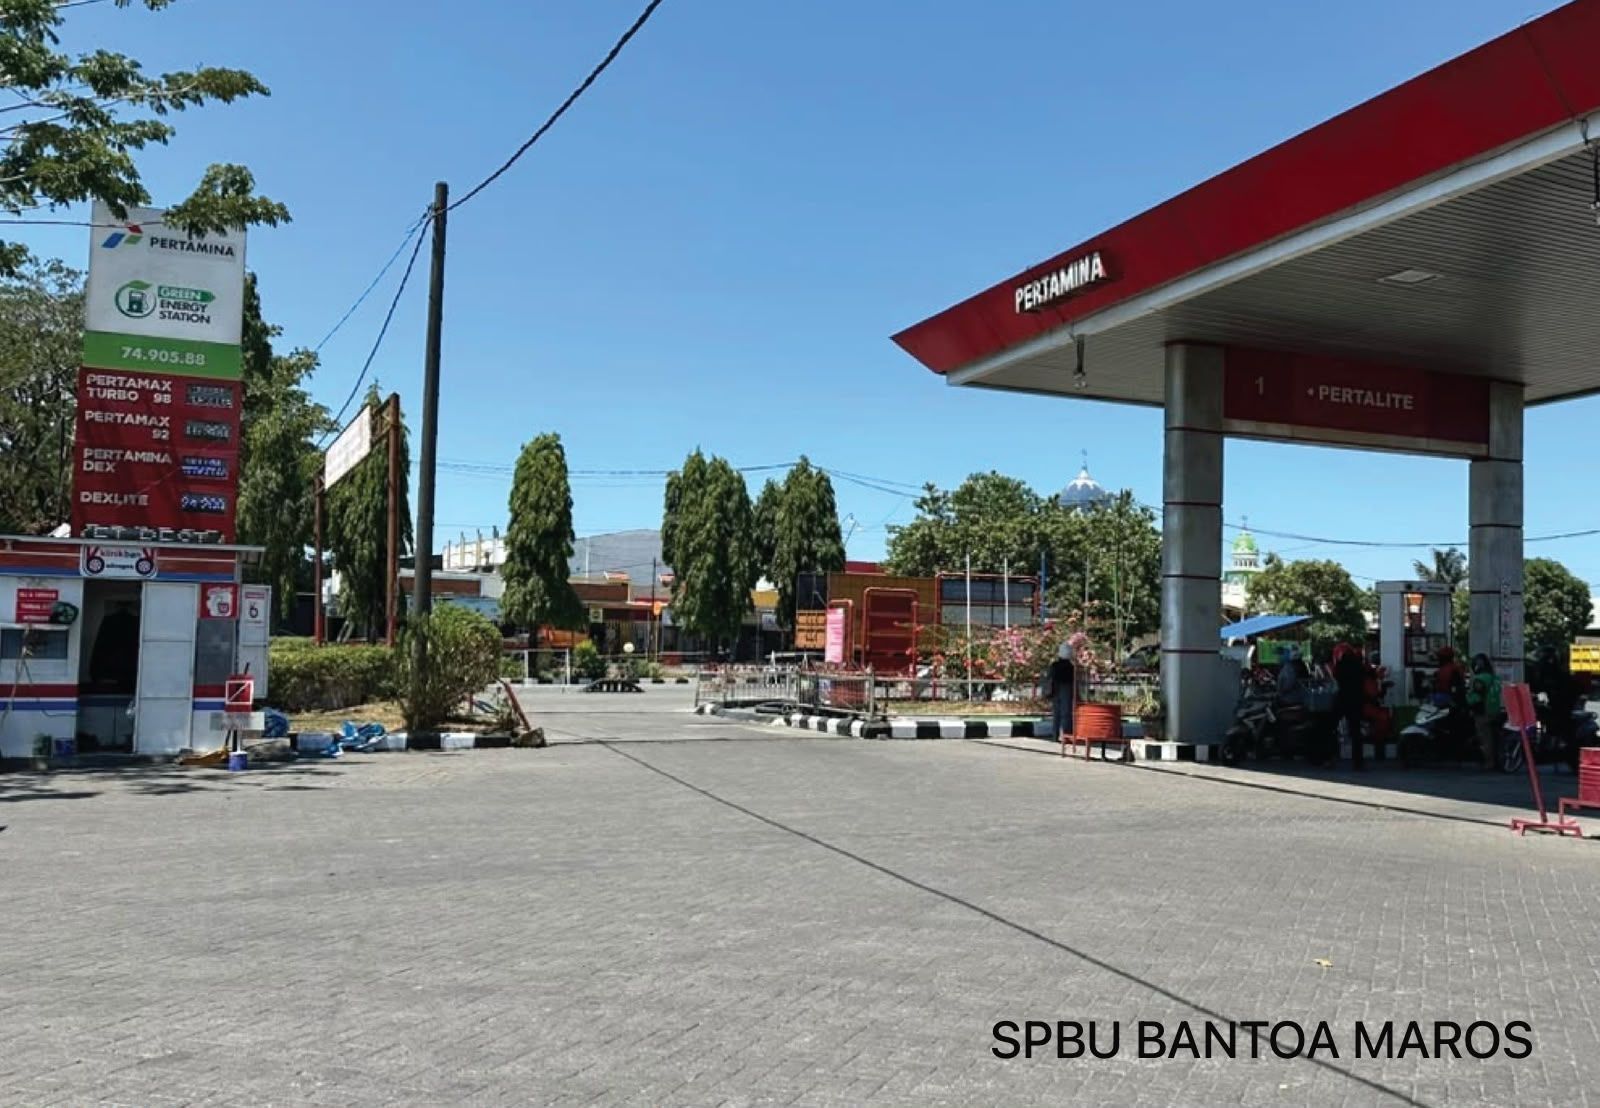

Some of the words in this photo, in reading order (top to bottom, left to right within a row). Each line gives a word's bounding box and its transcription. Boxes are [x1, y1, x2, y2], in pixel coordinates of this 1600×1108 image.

[150, 235, 235, 257] PERTAMINA
[1015, 251, 1107, 314] PERTAMINA
[160, 287, 202, 301] GREEN
[159, 300, 208, 313] ENERGY
[159, 310, 211, 324] STATION
[121, 346, 206, 365] 74.905.88
[86, 373, 172, 392] PERTAMAX
[1255, 376, 1265, 396] 1
[86, 387, 139, 401] TURBO
[153, 392, 172, 404] 98
[1318, 384, 1414, 410] PERTALITE
[84, 410, 170, 428] PERTAMAX
[152, 428, 170, 441] 92
[83, 448, 172, 464] PERTAMINA
[82, 461, 116, 473] DEX
[80, 491, 149, 506] DEXLITE
